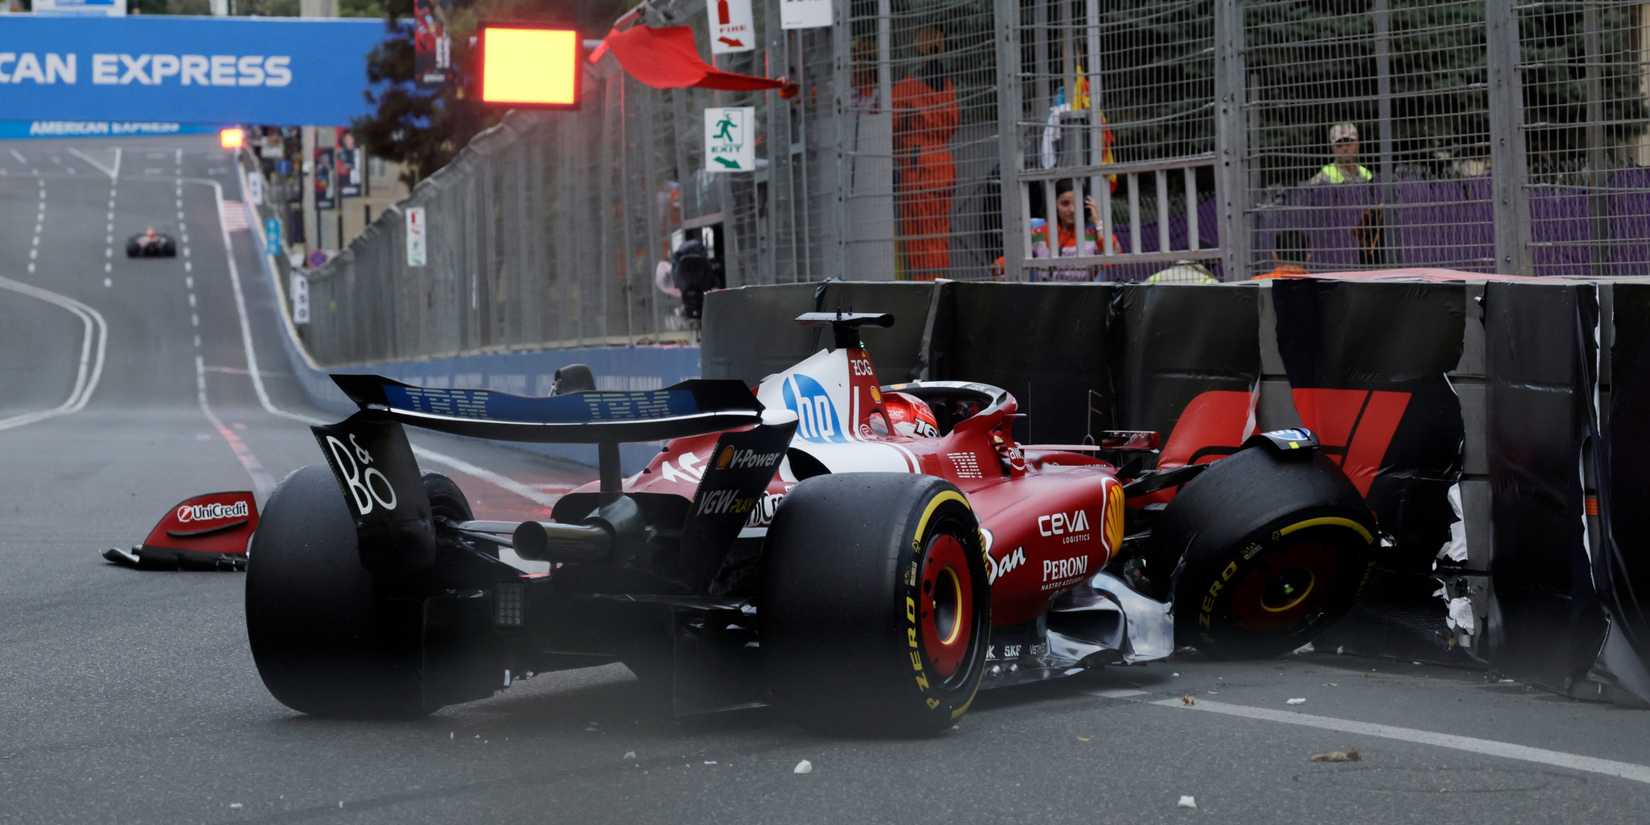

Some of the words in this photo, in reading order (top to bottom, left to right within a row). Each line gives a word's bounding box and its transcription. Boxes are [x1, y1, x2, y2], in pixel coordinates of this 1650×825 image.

[92, 54, 292, 87] EXPRESS
[711, 144, 743, 152] EXIT
[406, 388, 489, 418] IBM
[583, 391, 671, 418] IBM
[791, 374, 835, 443] hp
[913, 418, 939, 437] 16
[730, 448, 779, 470] V-Power
[946, 452, 983, 478] IBM
[192, 501, 248, 520] UniCredit
[1062, 533, 1090, 545] LOGISTICS
[1042, 555, 1089, 582] PERONI
[905, 595, 930, 693] ZERO
